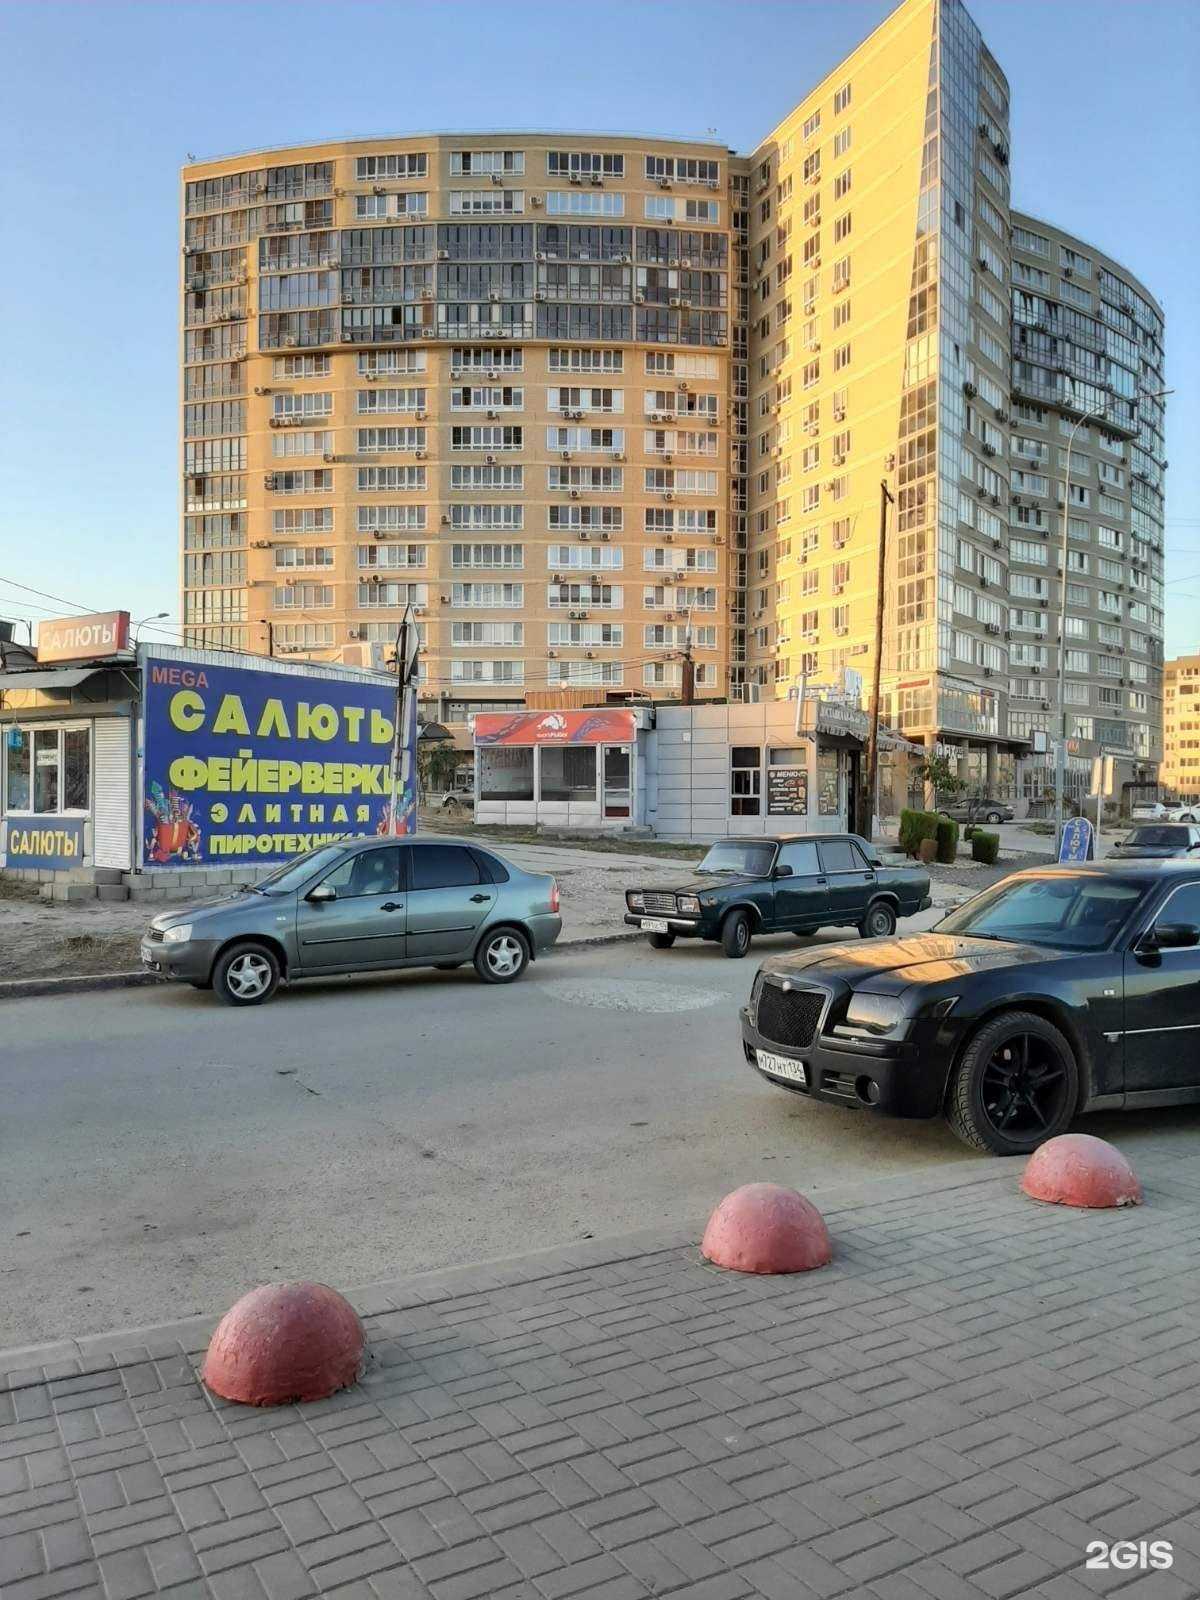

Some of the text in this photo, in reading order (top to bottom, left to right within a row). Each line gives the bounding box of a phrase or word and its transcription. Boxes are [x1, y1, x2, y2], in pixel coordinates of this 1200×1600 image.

[41, 622, 117, 649] САЛЮТЫ
[152, 666, 209, 689] MEGA
[210, 802, 370, 824] ЭЛИТНАЯ
[10, 829, 79, 857] САЛЮТЫ
